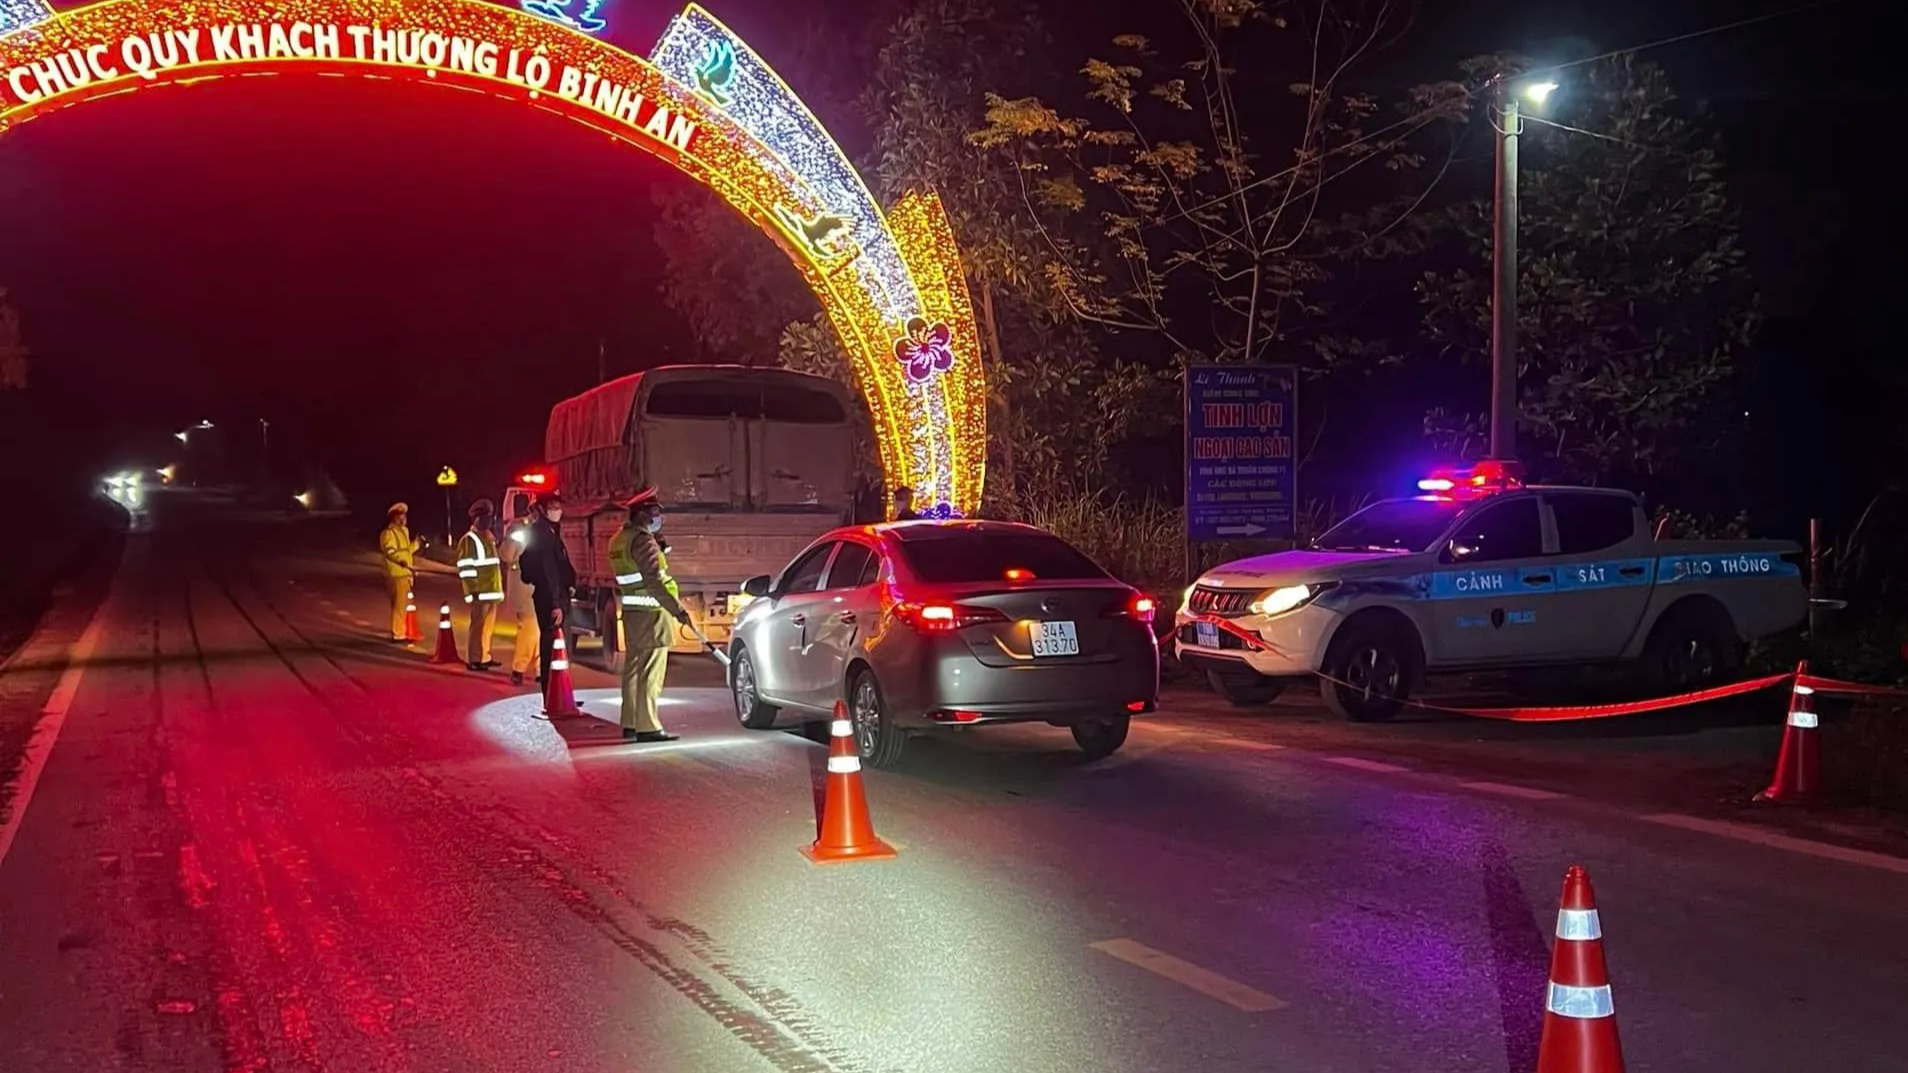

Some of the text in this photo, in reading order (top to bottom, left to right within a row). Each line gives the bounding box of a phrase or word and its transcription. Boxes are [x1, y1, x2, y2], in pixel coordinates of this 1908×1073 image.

[8, 39, 118, 103] CHÚC
[346, 25, 498, 78] THƯỢNG
[507, 43, 551, 99] LỘ
[645, 105, 696, 150] AN
[1236, 437, 1262, 458] CAO
[1456, 571, 1503, 591] CẢNH
[1579, 565, 1606, 583] SÁT
[1721, 555, 1770, 573] THÔNG
[1041, 623, 1066, 637] 34A
